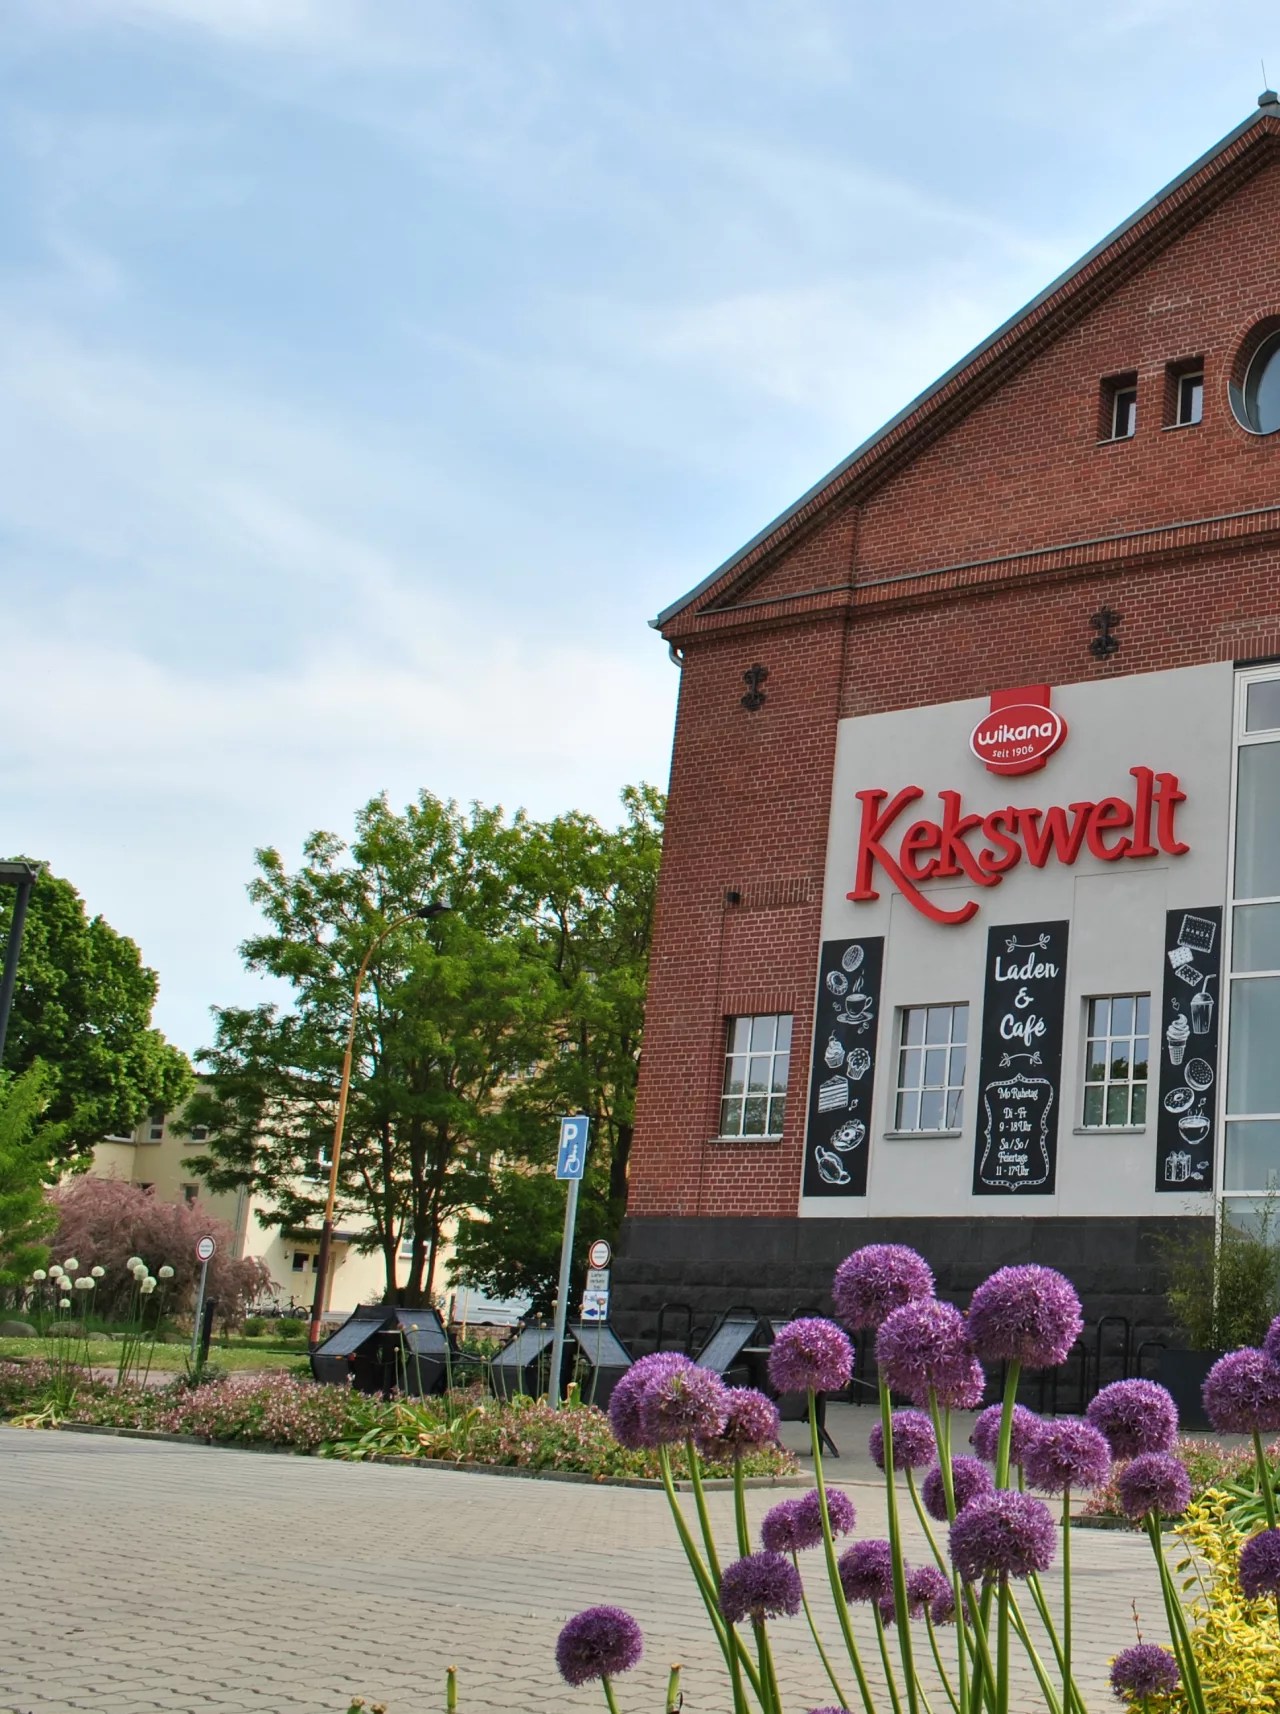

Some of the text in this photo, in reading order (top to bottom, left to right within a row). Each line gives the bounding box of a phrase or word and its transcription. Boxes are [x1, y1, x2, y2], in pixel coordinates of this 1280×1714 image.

[978, 722, 1053, 745] wikana
[992, 744, 1034, 758] seit 1906
[846, 766, 1190, 925] Kekswelt
[995, 952, 1060, 982] Laden
[1014, 986, 1034, 1009] &
[1000, 1013, 1047, 1046] Café
[997, 1087, 1039, 1101] Mo Ruhetag
[1003, 1107, 1013, 1119] Di
[1017, 1107, 1027, 1119] Fr
[1018, 1120, 1032, 1132] Uhr
[562, 1124, 578, 1149] P
[997, 1151, 1029, 1165] Feiertage
[1015, 1165, 1030, 1176] Uhr
